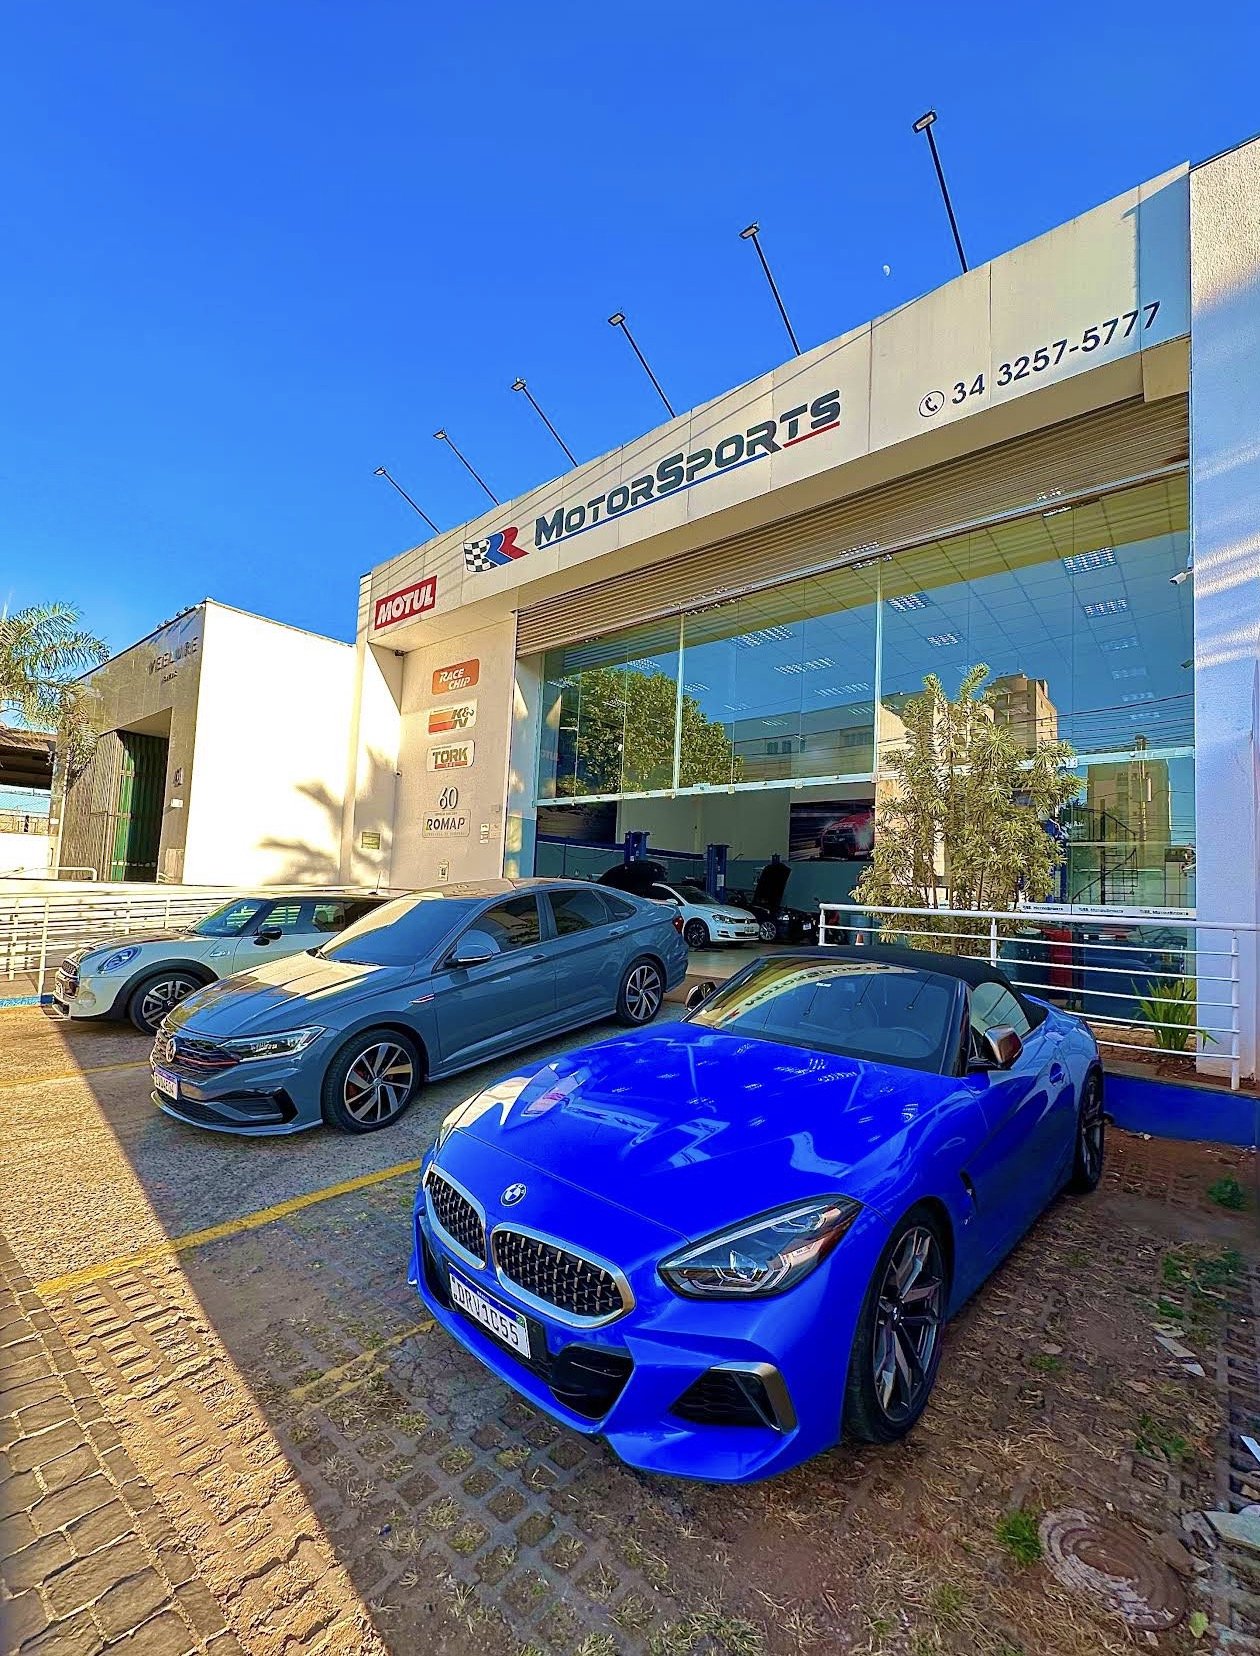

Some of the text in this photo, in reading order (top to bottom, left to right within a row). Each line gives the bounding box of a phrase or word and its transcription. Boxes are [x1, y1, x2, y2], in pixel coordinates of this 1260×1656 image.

[951, 301, 1161, 405] 34 3257-5777
[376, 583, 434, 626] MOTUL
[439, 668, 464, 684] RACE
[448, 677, 471, 690] CHIP
[432, 747, 468, 766] TORK
[439, 786, 459, 810] 60
[425, 817, 465, 831] ROMAP
